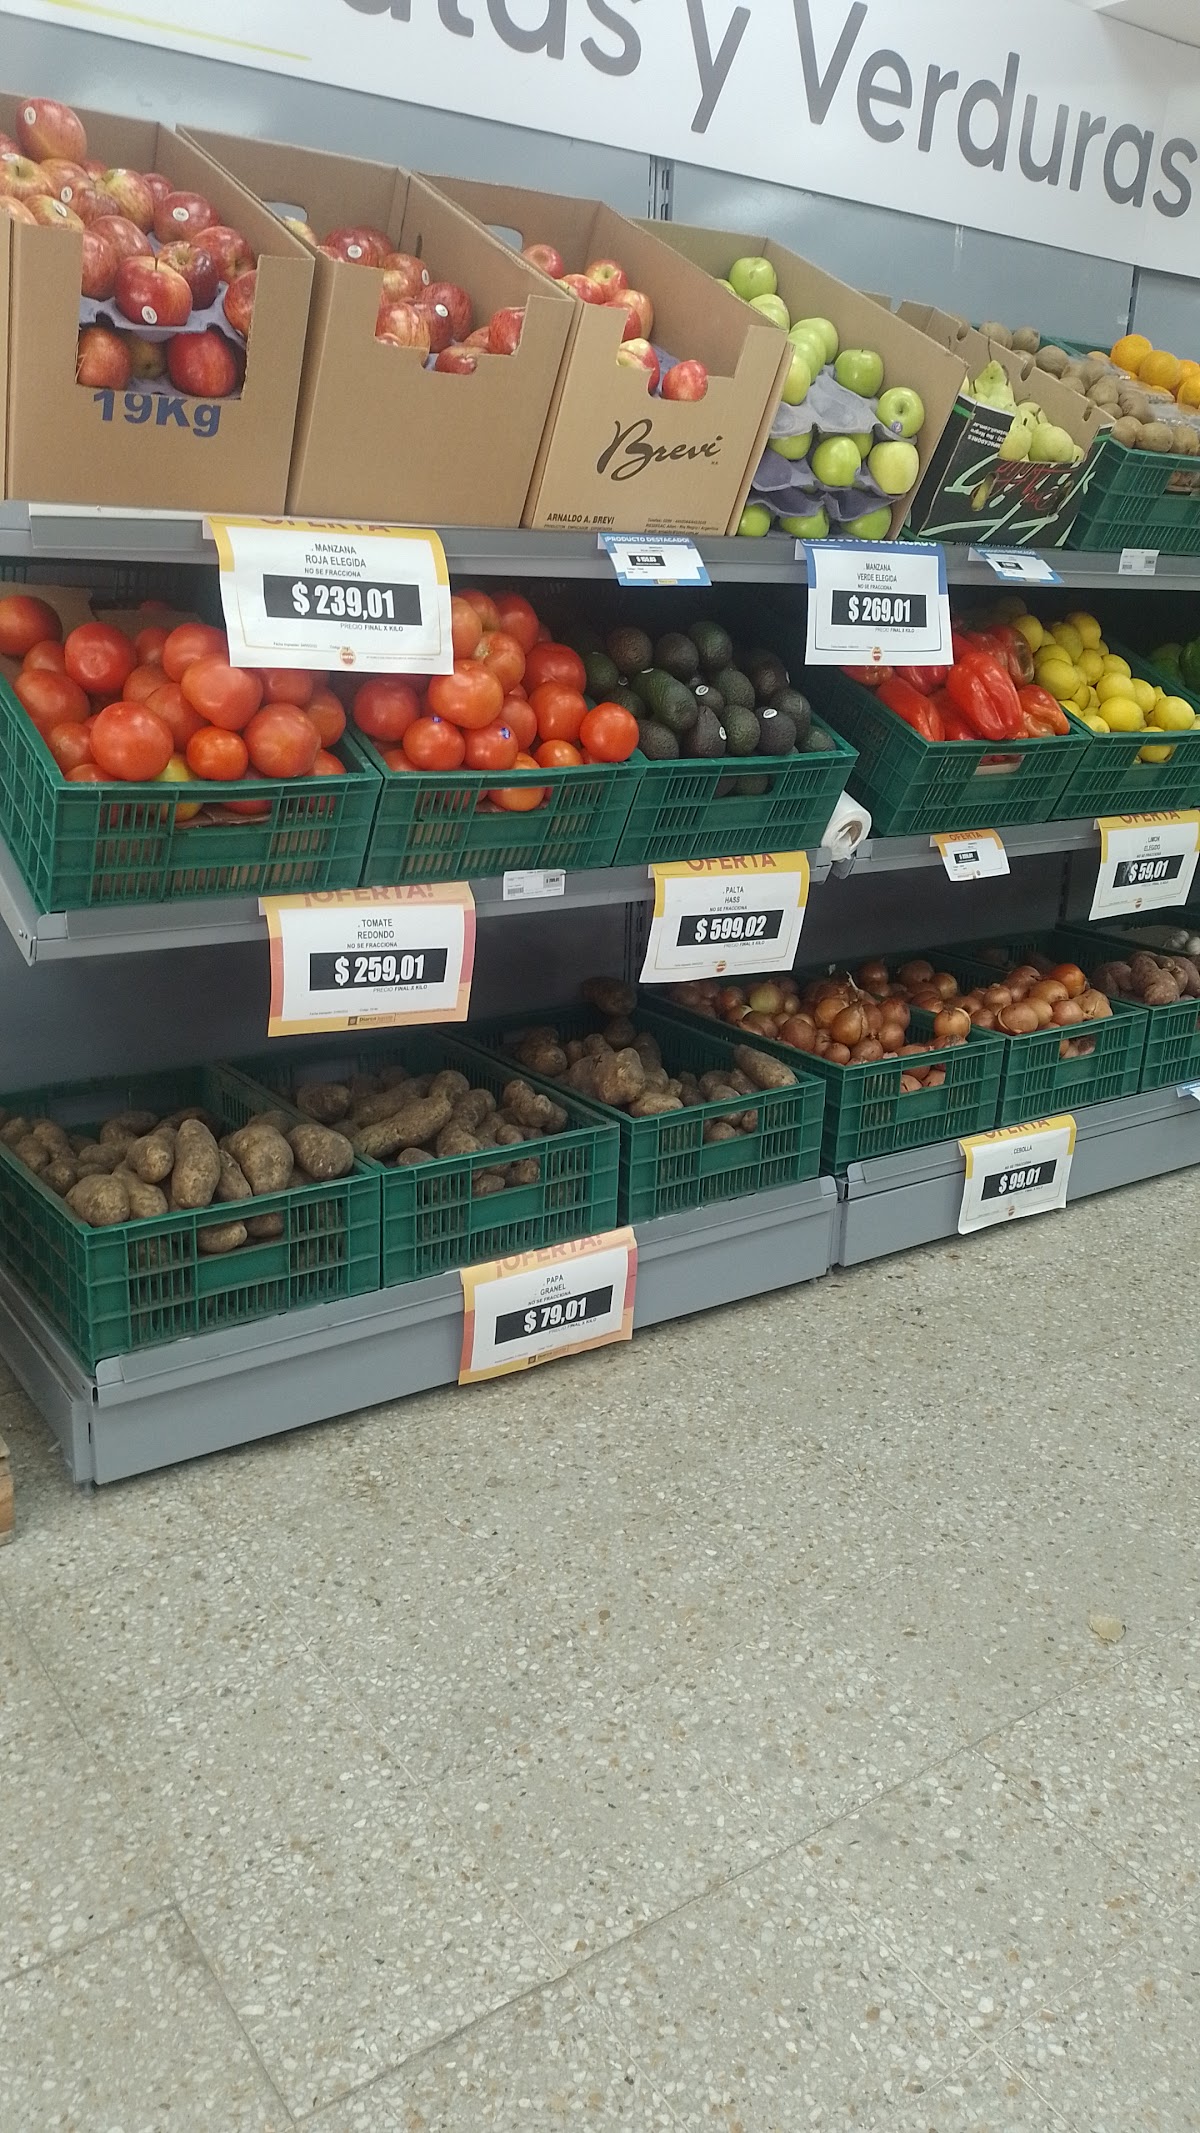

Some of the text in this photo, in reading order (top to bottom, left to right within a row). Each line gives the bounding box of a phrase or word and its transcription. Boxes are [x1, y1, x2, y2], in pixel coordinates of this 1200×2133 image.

[686, 0, 751, 134] y
[793, 0, 1199, 218] Verduras
[93, 390, 221, 437] 19Kg
[597, 418, 723, 481] Brevi
[547, 512, 615, 525] ARNALDO A. BREVI
[315, 543, 357, 554] MANZANA
[305, 554, 367, 568] ROJA ELEGIDA
[865, 562, 892, 571] MANZANA
[304, 567, 314, 575] NO
[324, 569, 362, 578] FRACCIONA
[857, 573, 875, 582] VERDE
[291, 580, 395, 621] $ 239,01
[848, 595, 911, 625] $ 269,01
[949, 832, 983, 841] OFERTA
[686, 854, 776, 871] OFERTA
[1128, 859, 1169, 884] $ 59,01
[304, 884, 434, 907] ¡OFERTA!
[726, 886, 744, 894] PALTA
[725, 896, 741, 904] HASS
[361, 918, 393, 928] TOMATE
[695, 915, 767, 942] $ 599,02
[357, 930, 395, 940] REDONDO
[334, 954, 425, 987] $ 259,01
[998, 1173, 1008, 1195] $
[1008, 1166, 1041, 1191] 99,01
[546, 1274, 564, 1285] PAPA
[540, 1283, 567, 1295] GRANEL
[523, 1296, 587, 1334] $ 79,01
